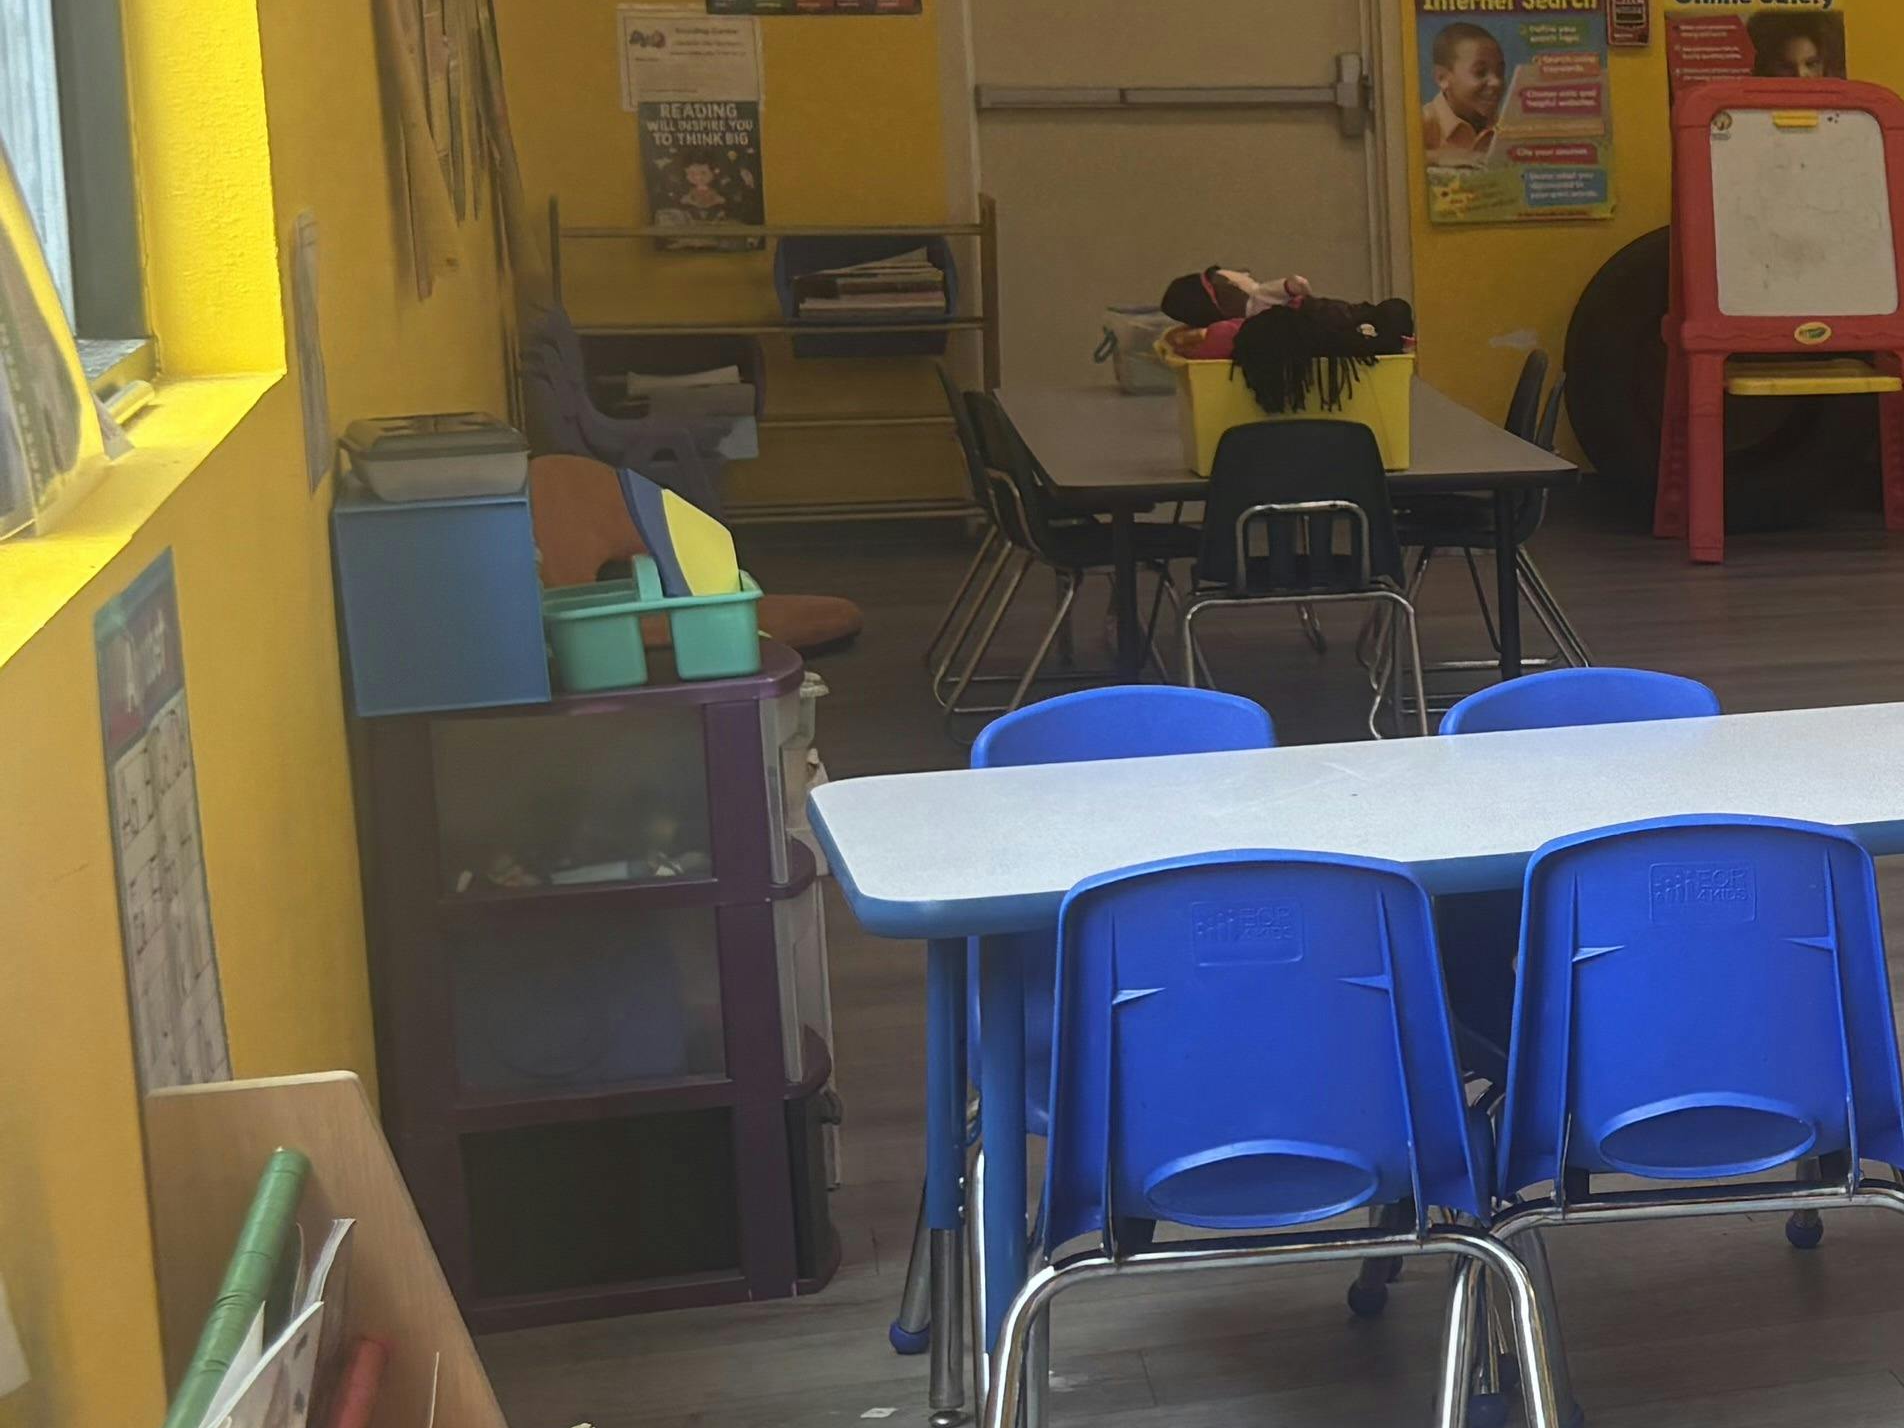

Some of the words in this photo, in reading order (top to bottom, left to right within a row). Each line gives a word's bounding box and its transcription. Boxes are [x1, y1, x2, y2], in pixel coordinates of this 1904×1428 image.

[659, 103, 737, 118] READING
[646, 121, 674, 132] WILL
[678, 121, 725, 132] INSPIRE
[728, 120, 753, 131] YOU
[653, 133, 672, 146] TO
[677, 133, 723, 146] THINK
[726, 132, 749, 145] BIG
